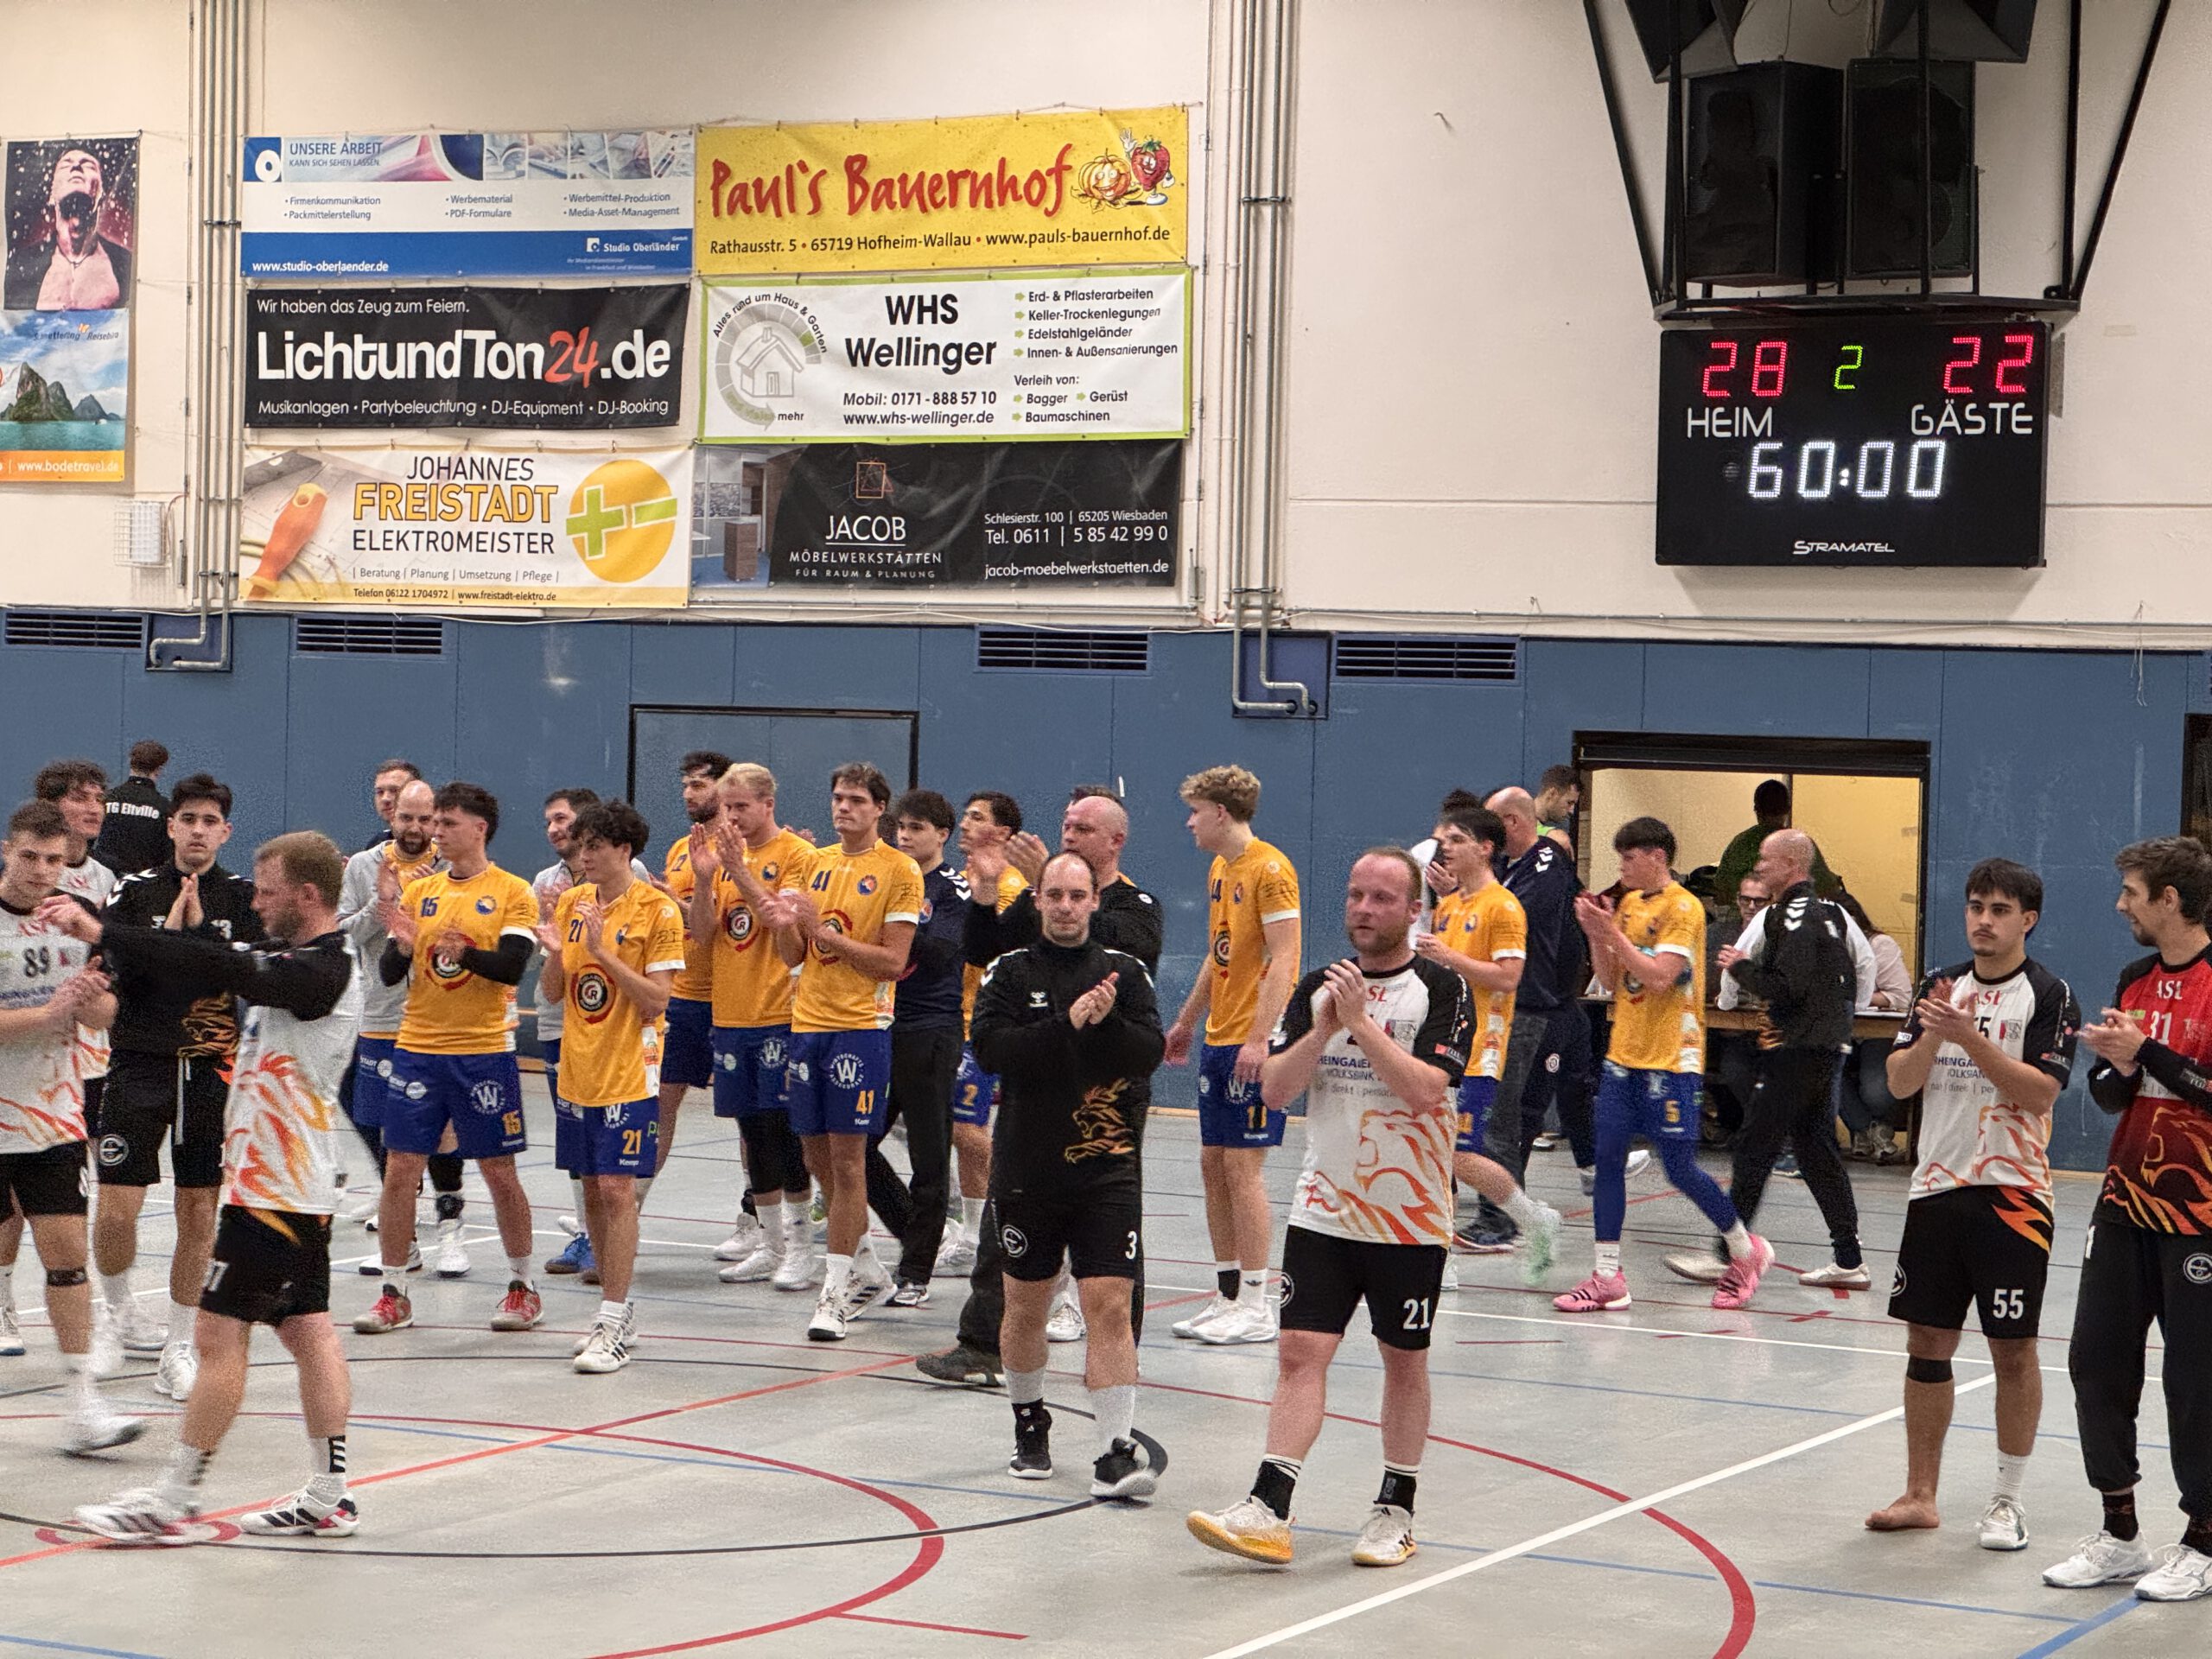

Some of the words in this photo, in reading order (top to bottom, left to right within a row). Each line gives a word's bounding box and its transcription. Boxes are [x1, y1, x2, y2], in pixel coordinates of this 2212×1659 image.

[289, 143, 336, 156] UNSERE
[340, 142, 383, 155] ARBEIT
[843, 143, 1074, 218] Bauernhof
[289, 196, 381, 206] Firmenkommunikation
[450, 194, 513, 204] Werbematerial
[569, 193, 671, 204] Werbemittel-Produktion
[289, 210, 372, 221] Packmittelerstellung
[449, 208, 512, 218] PDF-Formulare
[569, 206, 680, 219] Media-Asset-Management
[603, 242, 631, 252] Studio
[632, 241, 680, 252] Oberländer
[710, 239, 785, 255] Rathausstr.
[788, 238, 798, 252] 5
[810, 238, 853, 251] 65719
[857, 232, 972, 251] Hofheim-Wallau
[985, 226, 1171, 249] www.pauls-bauernhof.de
[251, 259, 389, 272] www.studio-oberlaender.de
[1028, 291, 1050, 302] Erd-
[1052, 291, 1061, 302] &
[1064, 289, 1154, 302] Pflasterarbeiten
[257, 299, 277, 313] Wir
[280, 299, 327, 314] haben
[330, 299, 354, 314] das
[357, 299, 391, 316] Zeug
[394, 302, 423, 314] zum
[426, 299, 470, 314] Feiern.
[885, 294, 959, 325] WHS
[1028, 307, 1160, 321] Keller-Trockenlegungen
[713, 313, 732, 338] Alles
[754, 294, 771, 302] um
[773, 293, 800, 310] Haus
[799, 306, 808, 317] &
[807, 315, 828, 353] Garten
[1027, 327, 1133, 340] Edelstahlgeländer
[257, 326, 671, 388] LichtundTon24.de
[845, 337, 998, 374] Wellinger
[1027, 347, 1062, 358] Innen-
[1065, 346, 1073, 358] &
[1076, 344, 1179, 359] Außensanierungen
[1701, 340, 1788, 397] 28
[1833, 344, 1864, 391] 2
[1942, 334, 2034, 395] 22
[1014, 375, 1052, 386] Verleih
[1055, 376, 1080, 385] von:
[843, 391, 888, 406] Mobil:
[891, 391, 923, 406] 0171
[932, 391, 959, 405] 888
[961, 391, 977, 405] 57
[979, 391, 997, 405] 10
[1026, 393, 1068, 406] Bagger
[1090, 391, 1128, 403] Gerüst
[258, 399, 350, 415] Musikanlagen
[361, 399, 477, 417] Partybeleuchtung
[491, 400, 584, 417] DJ-Equipment
[597, 399, 669, 416] DJ-Booking
[778, 411, 804, 421] mehr
[1026, 410, 1110, 423] Baumaschinen
[843, 410, 995, 428] www.whs-wellinger.de
[1687, 407, 1773, 438] HEIM
[1910, 399, 2033, 436] GÄSTE
[17, 461, 119, 474] www.bodetravel.de
[407, 456, 535, 481] JOHANNES
[1747, 439, 1948, 499] 60:00
[353, 482, 559, 524] FREISTADT
[984, 512, 1041, 524] Schlesierstr.
[1044, 512, 1064, 523] 100
[1078, 511, 1109, 522] 65205
[1111, 509, 1168, 522] Wiesbaden
[825, 515, 906, 542] JACOB
[985, 528, 1009, 544] Tel.
[1014, 527, 1050, 543] 0611
[1073, 526, 1083, 543] 5
[1087, 526, 1106, 542] 85
[1109, 526, 1128, 542] 42
[1133, 525, 1154, 542] 99
[1158, 525, 1168, 541] 0
[353, 530, 555, 554] ELEKTROMEISTER
[1792, 540, 1896, 556] STRAMATEL
[789, 549, 943, 564] MÖBELWERKSTÄTTEN
[359, 568, 401, 580] Beratung
[410, 568, 449, 581] Planung
[459, 569, 512, 582] Umsetzung
[522, 570, 553, 583] Pflege
[795, 568, 817, 576] FÜR
[984, 559, 1169, 581] jacob-moebelwerkstaetten.de
[353, 588, 384, 598] Telefon
[385, 588, 410, 598] 06122
[411, 589, 448, 599] 1704972
[458, 590, 556, 601] www.freistadt-elektro.de
[810, 869, 833, 892] 41
[420, 896, 440, 918] 15
[568, 918, 584, 943] 21
[22, 945, 50, 978] 89
[1367, 985, 1387, 1002] SL
[2148, 1011, 2172, 1045] 31
[855, 1090, 875, 1115] 41
[622, 1129, 643, 1155] 21
[1125, 1230, 1138, 1260] 3
[1993, 1287, 2024, 1320] 55
[1403, 1298, 1430, 1330] 21
